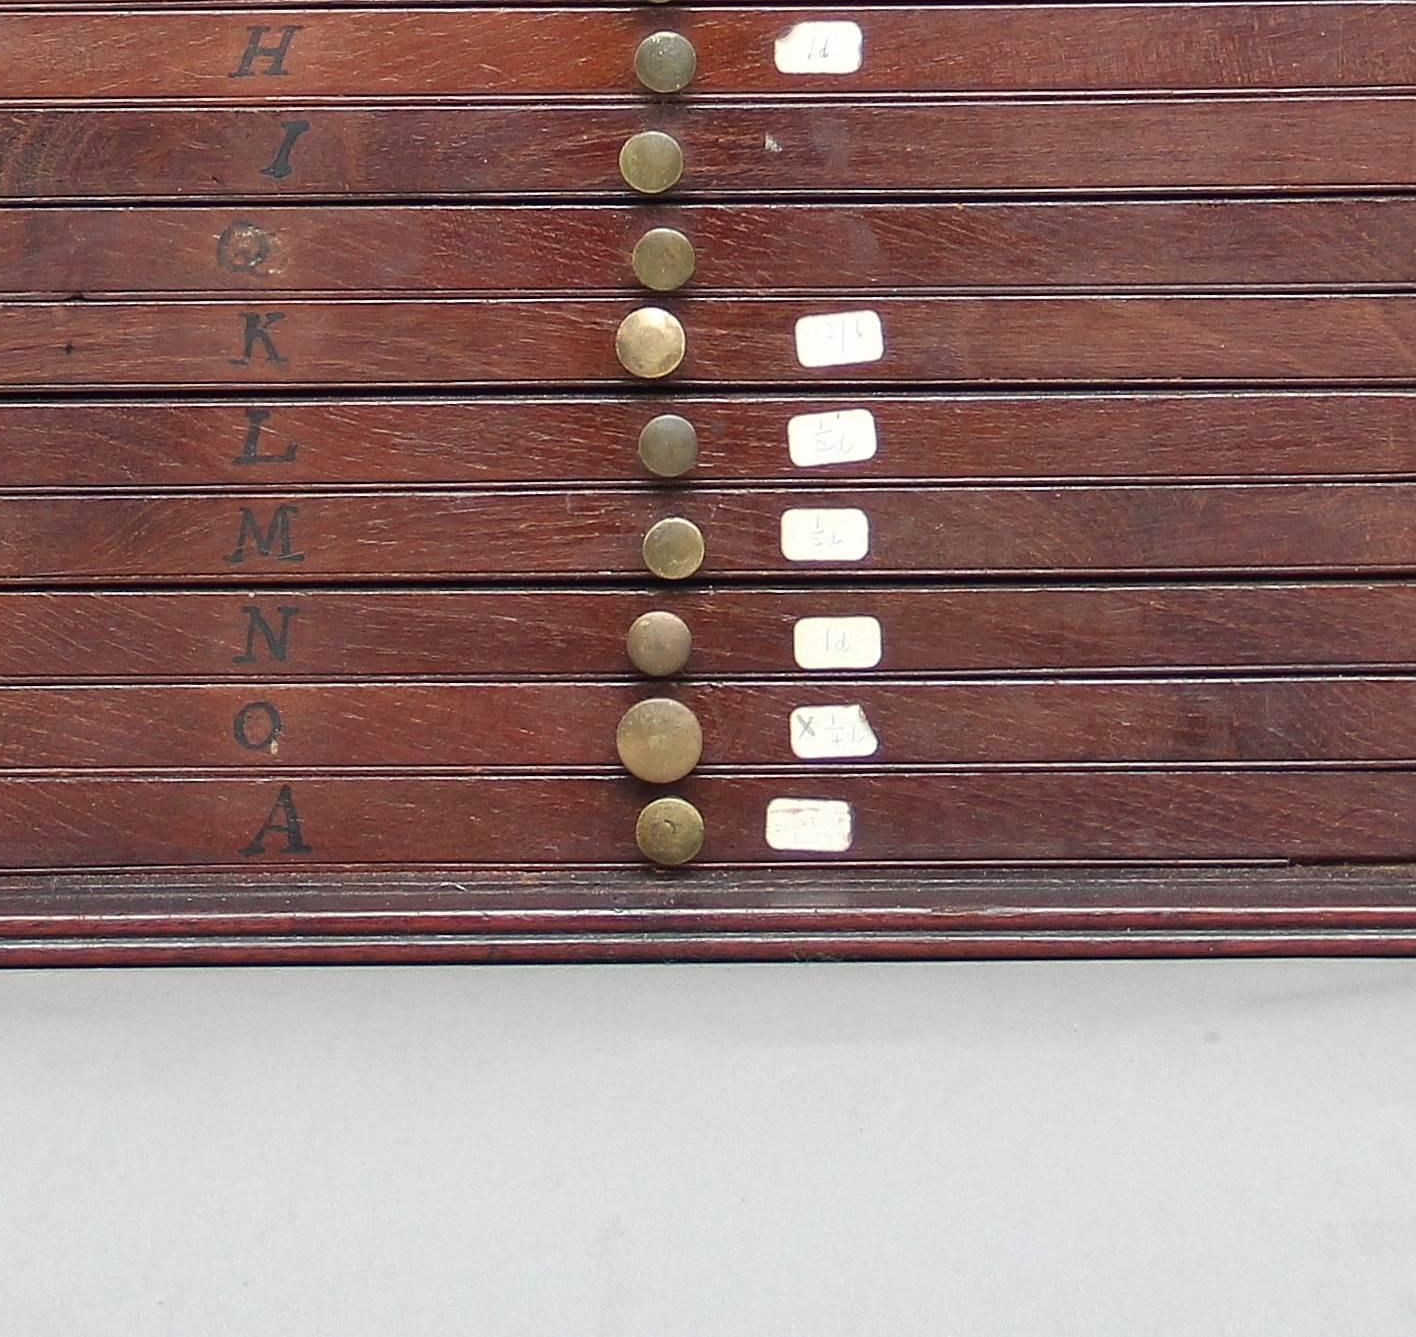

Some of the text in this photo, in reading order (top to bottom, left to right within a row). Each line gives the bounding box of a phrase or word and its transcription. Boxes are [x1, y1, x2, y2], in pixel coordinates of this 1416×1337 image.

[230, 24, 304, 78] H
[261, 119, 310, 178] I
[230, 310, 288, 365] K
[235, 408, 298, 466] L
[225, 504, 305, 563] M
[235, 605, 299, 664] N
[240, 783, 313, 858] A
